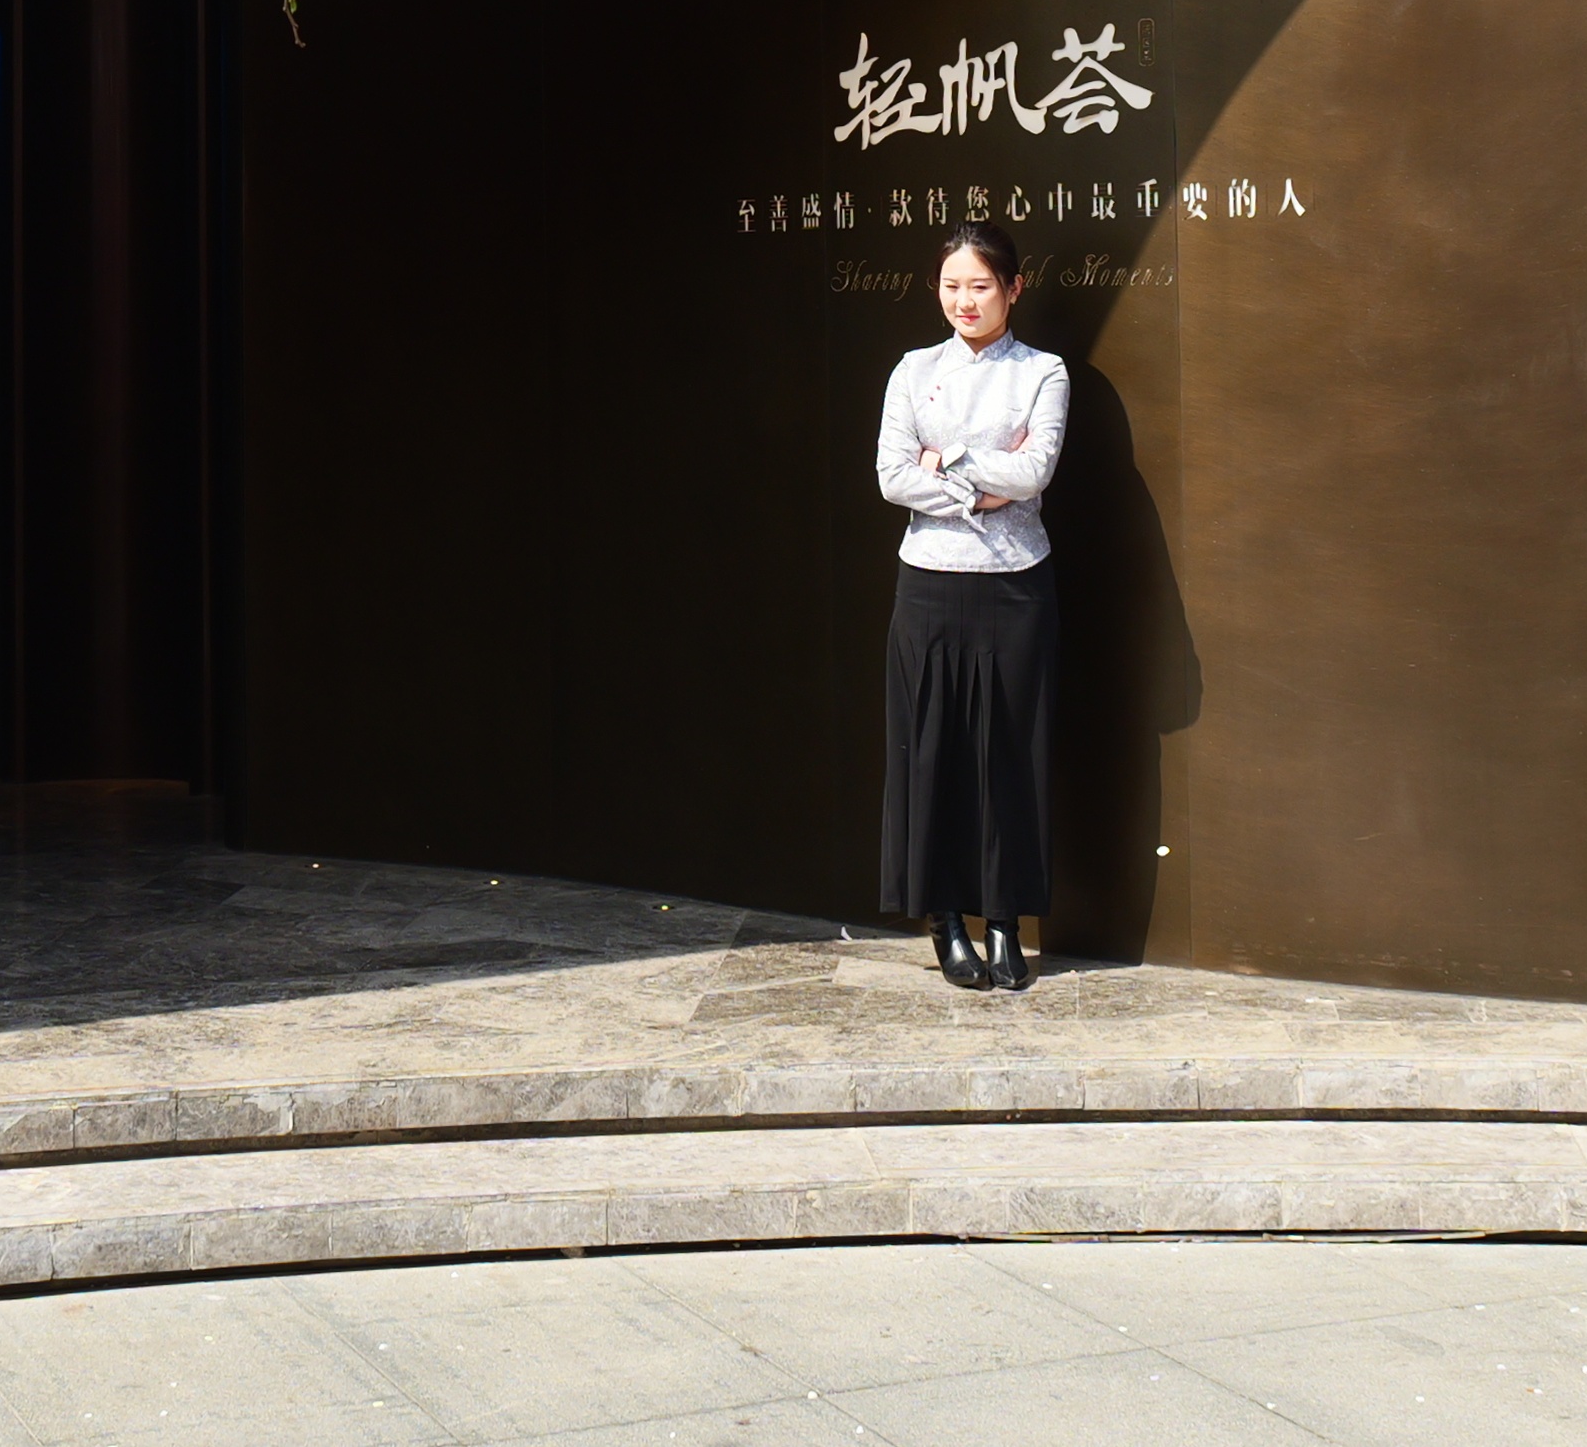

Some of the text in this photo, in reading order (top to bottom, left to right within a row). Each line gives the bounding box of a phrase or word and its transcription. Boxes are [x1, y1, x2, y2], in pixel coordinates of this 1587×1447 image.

[834, 23, 1154, 150] 轻帆荟
[830, 259, 913, 301] Sharing
[1060, 253, 1175, 289] Moments
